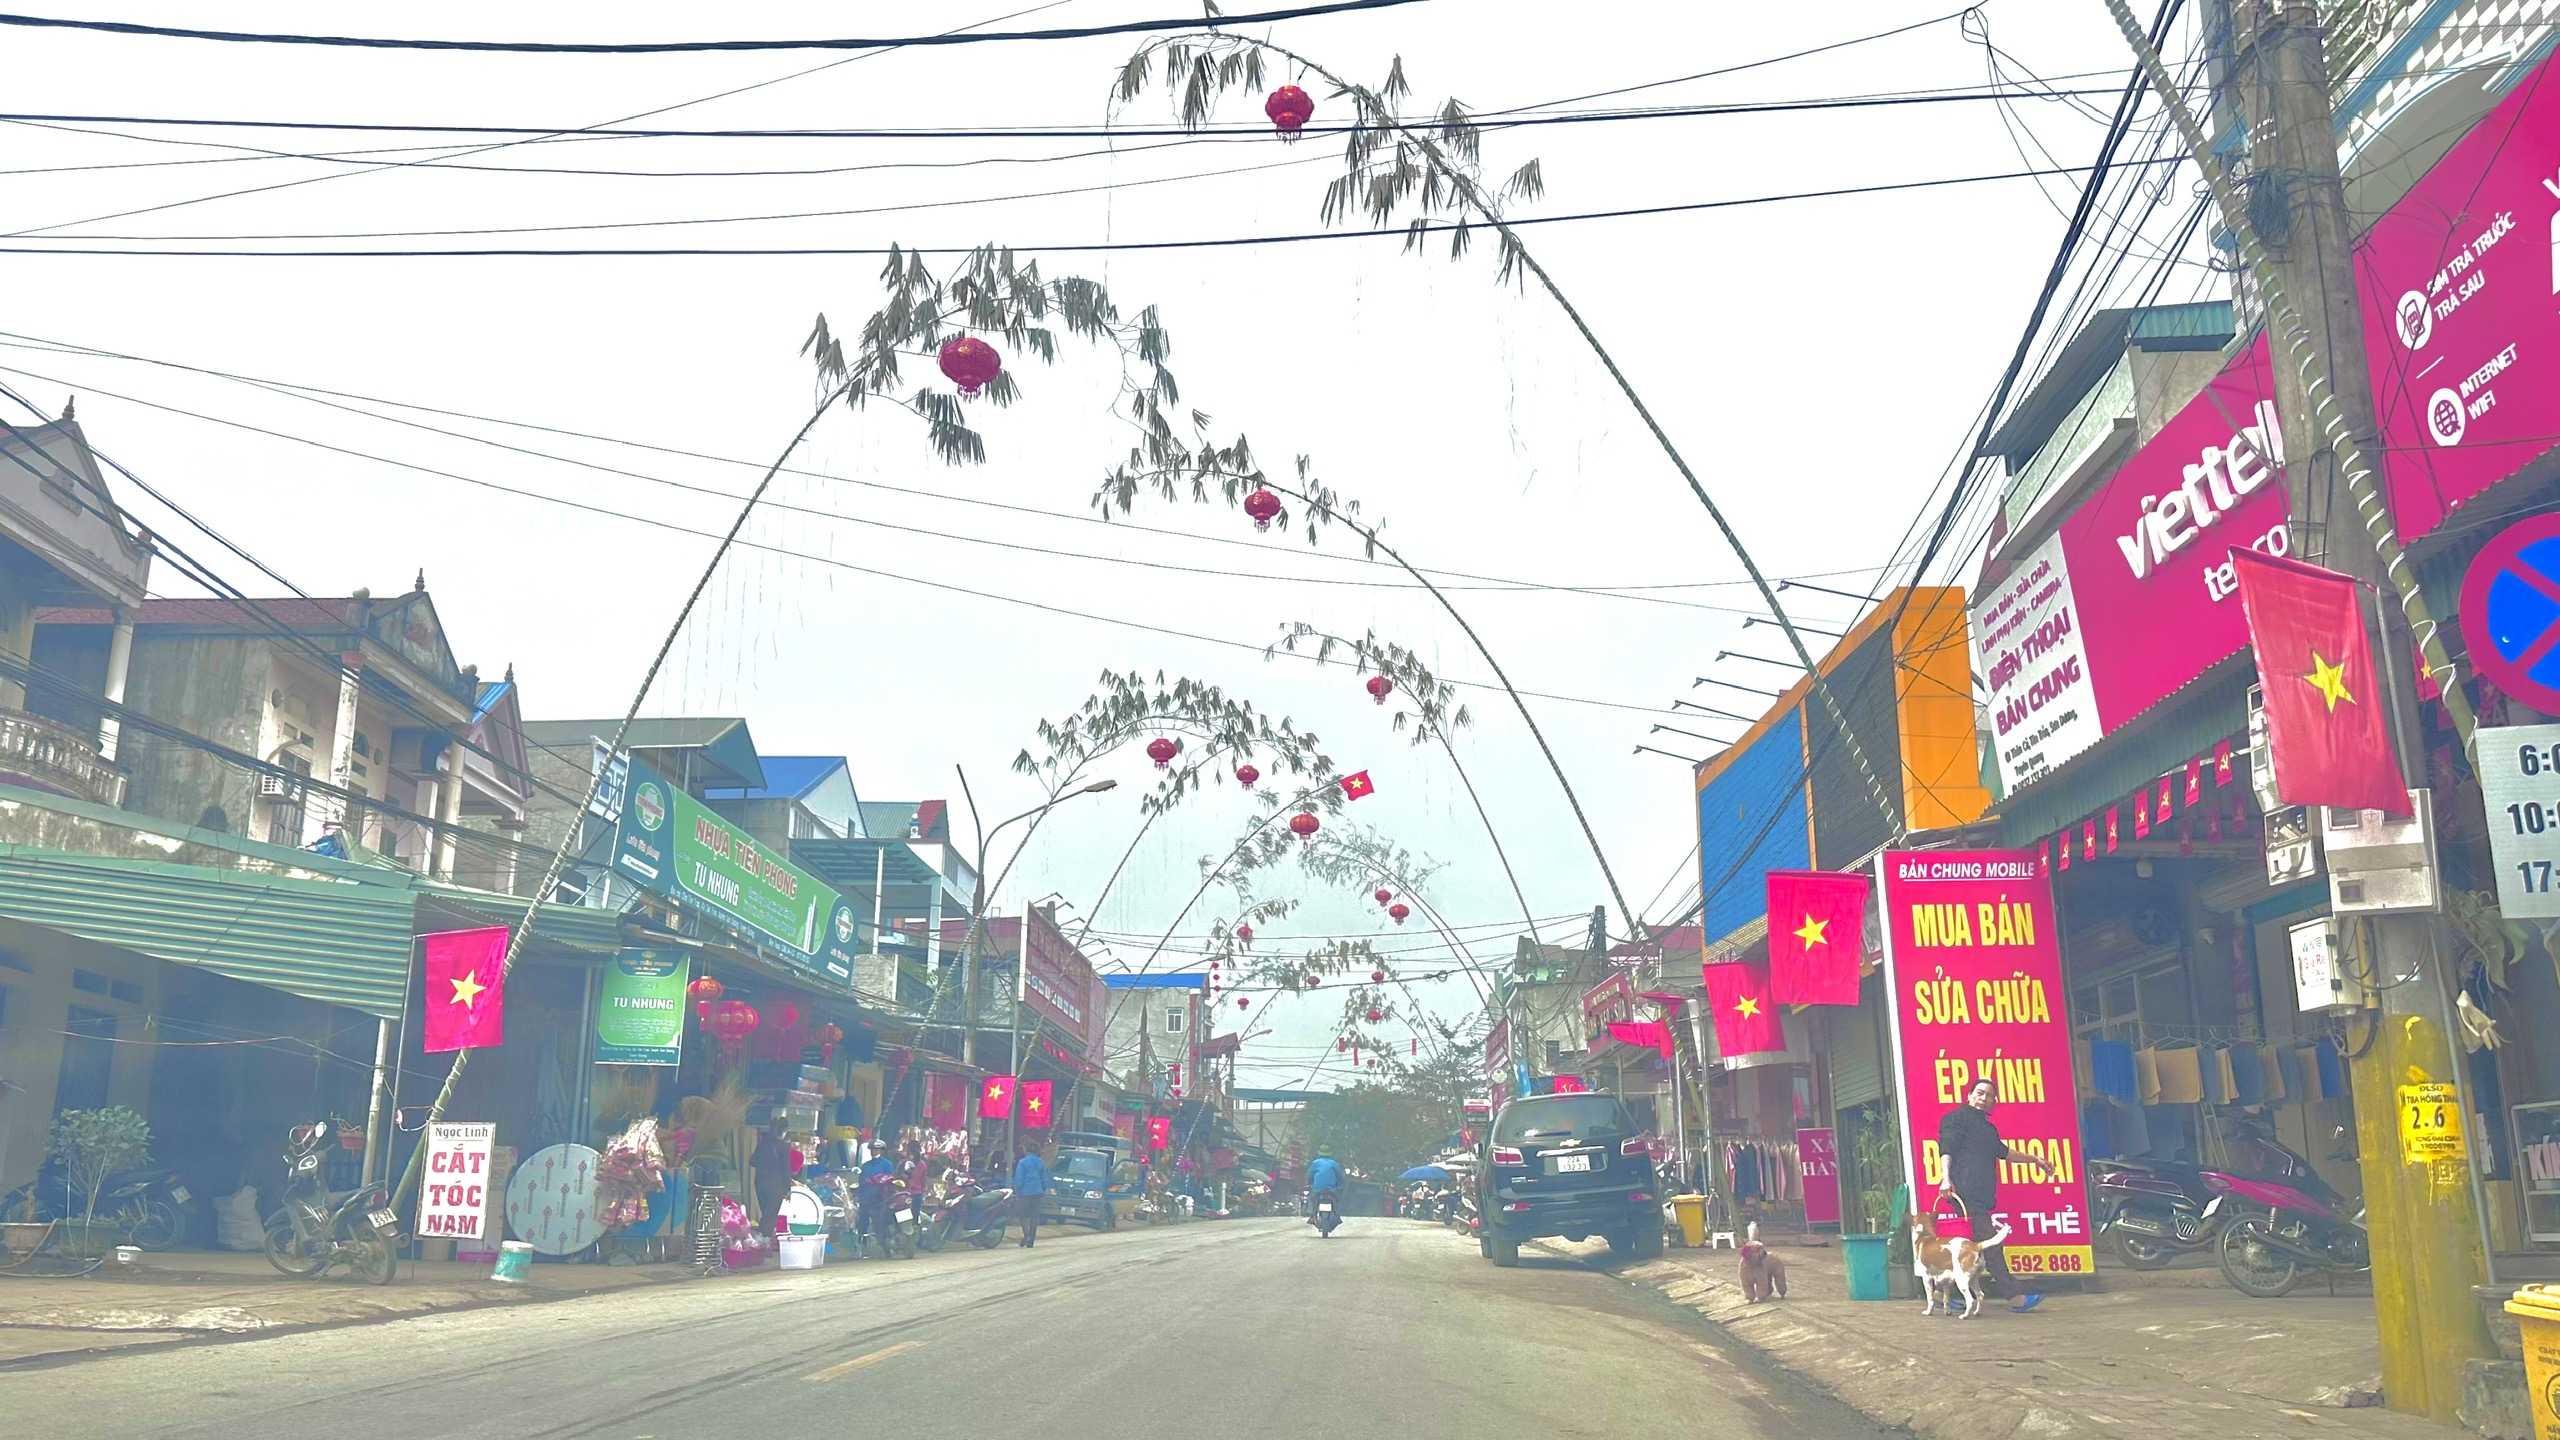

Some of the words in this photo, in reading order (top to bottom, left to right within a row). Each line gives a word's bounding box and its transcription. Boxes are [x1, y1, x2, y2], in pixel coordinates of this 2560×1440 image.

[2448, 243, 2475, 277] TRẢ
[2471, 211, 2517, 257] TRƯỚC
[2434, 289, 2460, 321] TRẢ
[2456, 270, 2486, 306] SAU
[2458, 343, 2518, 398] INTERNET
[2467, 389, 2496, 421] WIFI
[2117, 400, 2285, 579] viettel
[1989, 648, 2022, 693] ĐIỆN
[2021, 606, 2071, 664] THOẠI
[1996, 694, 2028, 736] BẢN
[2028, 654, 2081, 712] CHUNG
[695, 815, 730, 860] NHỰA
[762, 859, 798, 900] PHONG
[1899, 859, 1927, 879] BẢN
[1931, 863, 1982, 878] CHUNG
[1985, 862, 2035, 878] MOBILE
[707, 869, 740, 906] NHUNG
[1911, 903, 1973, 947] MUA
[1978, 894, 2035, 946] BÁN
[632, 998, 674, 1010] NHUNG
[1914, 965, 1971, 1025] SỬA
[1975, 971, 2050, 1024] CHỮA
[1935, 1049, 1969, 1104] ÉP
[435, 1127, 462, 1139] Ngọc
[465, 1127, 488, 1137] Linh
[431, 1143, 486, 1174] CẮT
[429, 1180, 482, 1207] TÓC
[427, 1215, 478, 1235] NAM
[2021, 1205, 2080, 1234] THẺ
[2010, 1254, 2044, 1272] 592
[2049, 1254, 2082, 1272] 888
